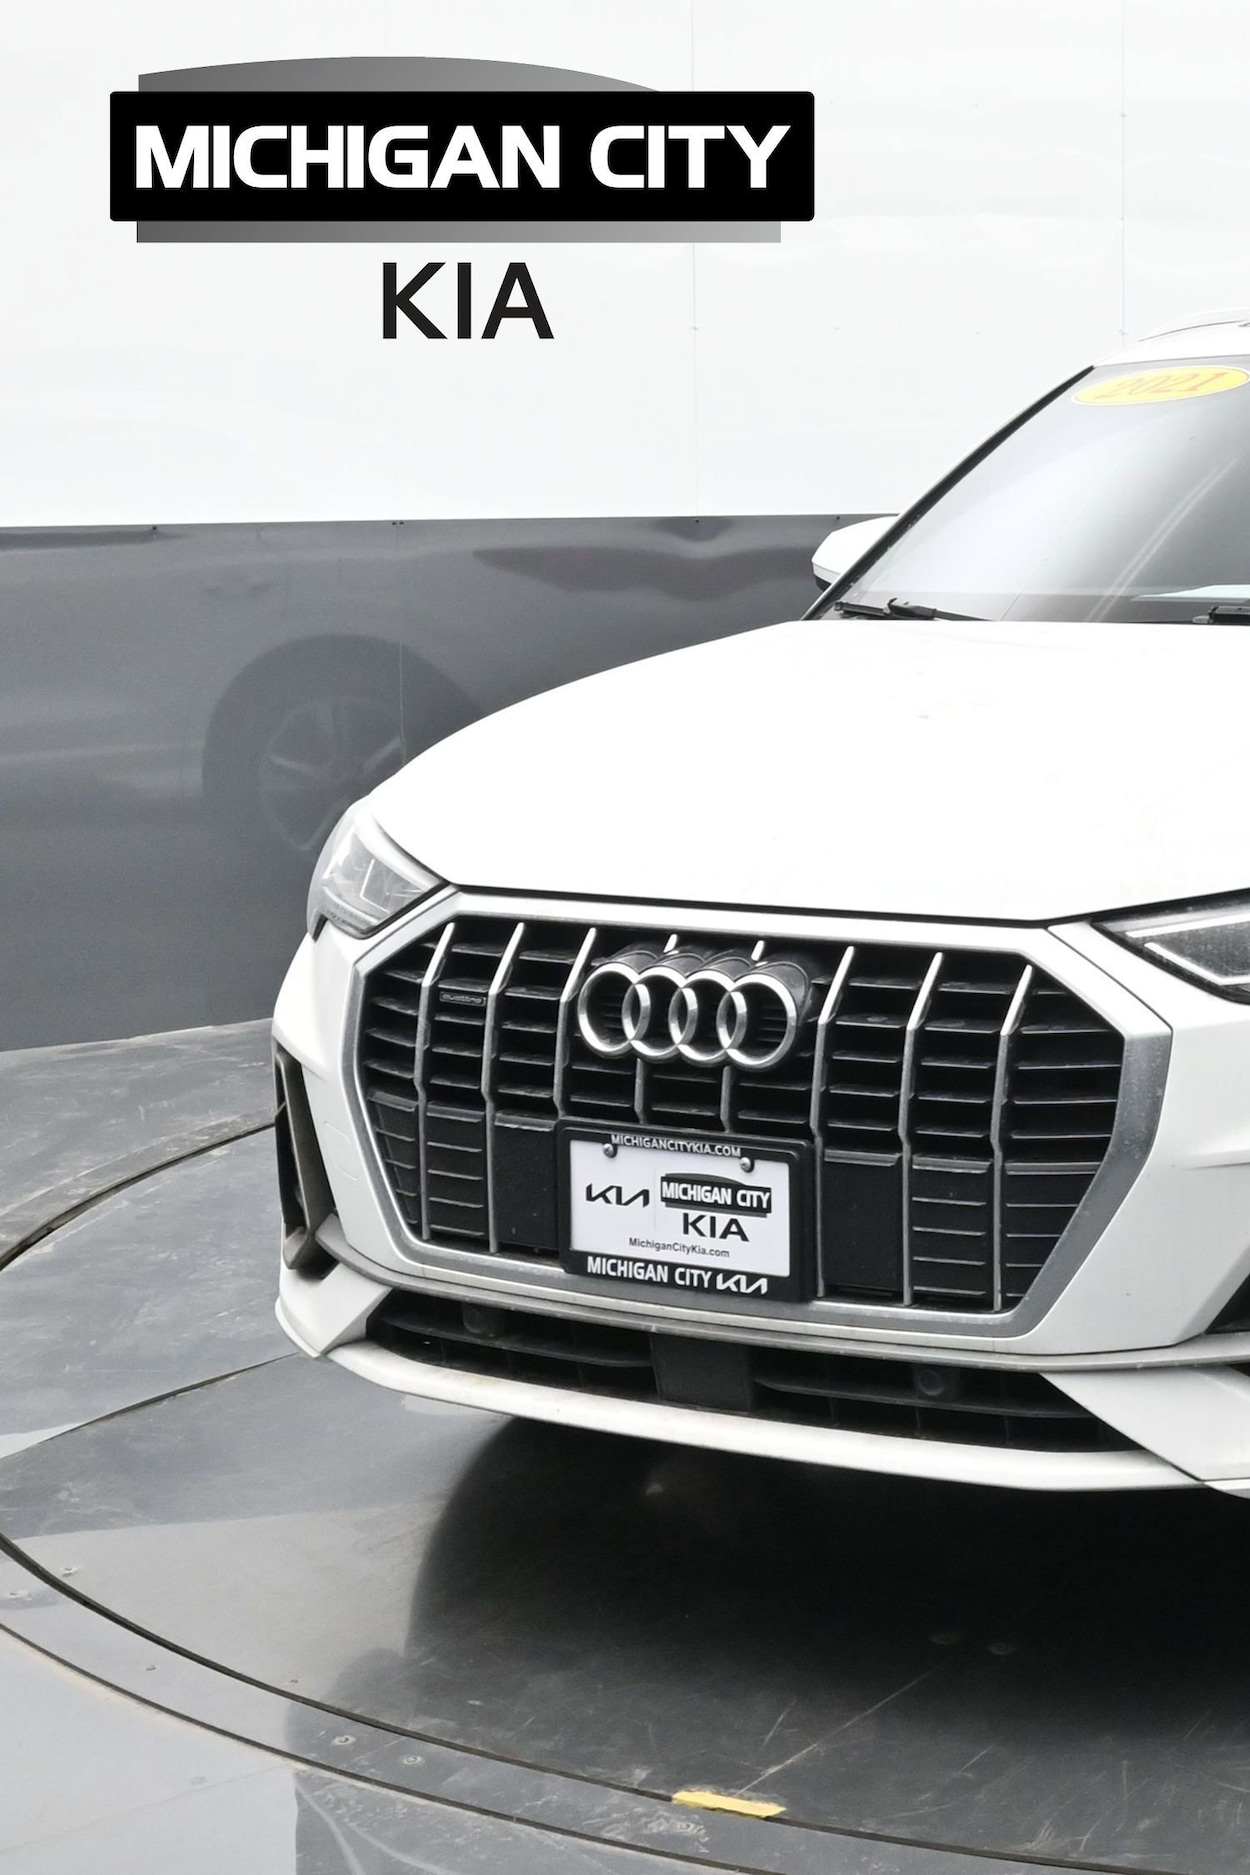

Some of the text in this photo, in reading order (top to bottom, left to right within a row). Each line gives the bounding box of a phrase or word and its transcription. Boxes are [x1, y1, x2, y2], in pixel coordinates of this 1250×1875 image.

[1094, 371, 1230, 400] 2021
[611, 1134, 741, 1157] MICHIGANCITYKIA.COM
[661, 1181, 770, 1209] MICHIGAN CITY
[682, 1212, 749, 1242] KIA
[629, 1237, 730, 1257] MichiganCityKia.com
[587, 1256, 668, 1283] MICHIGAN
[674, 1267, 712, 1289] CITY
